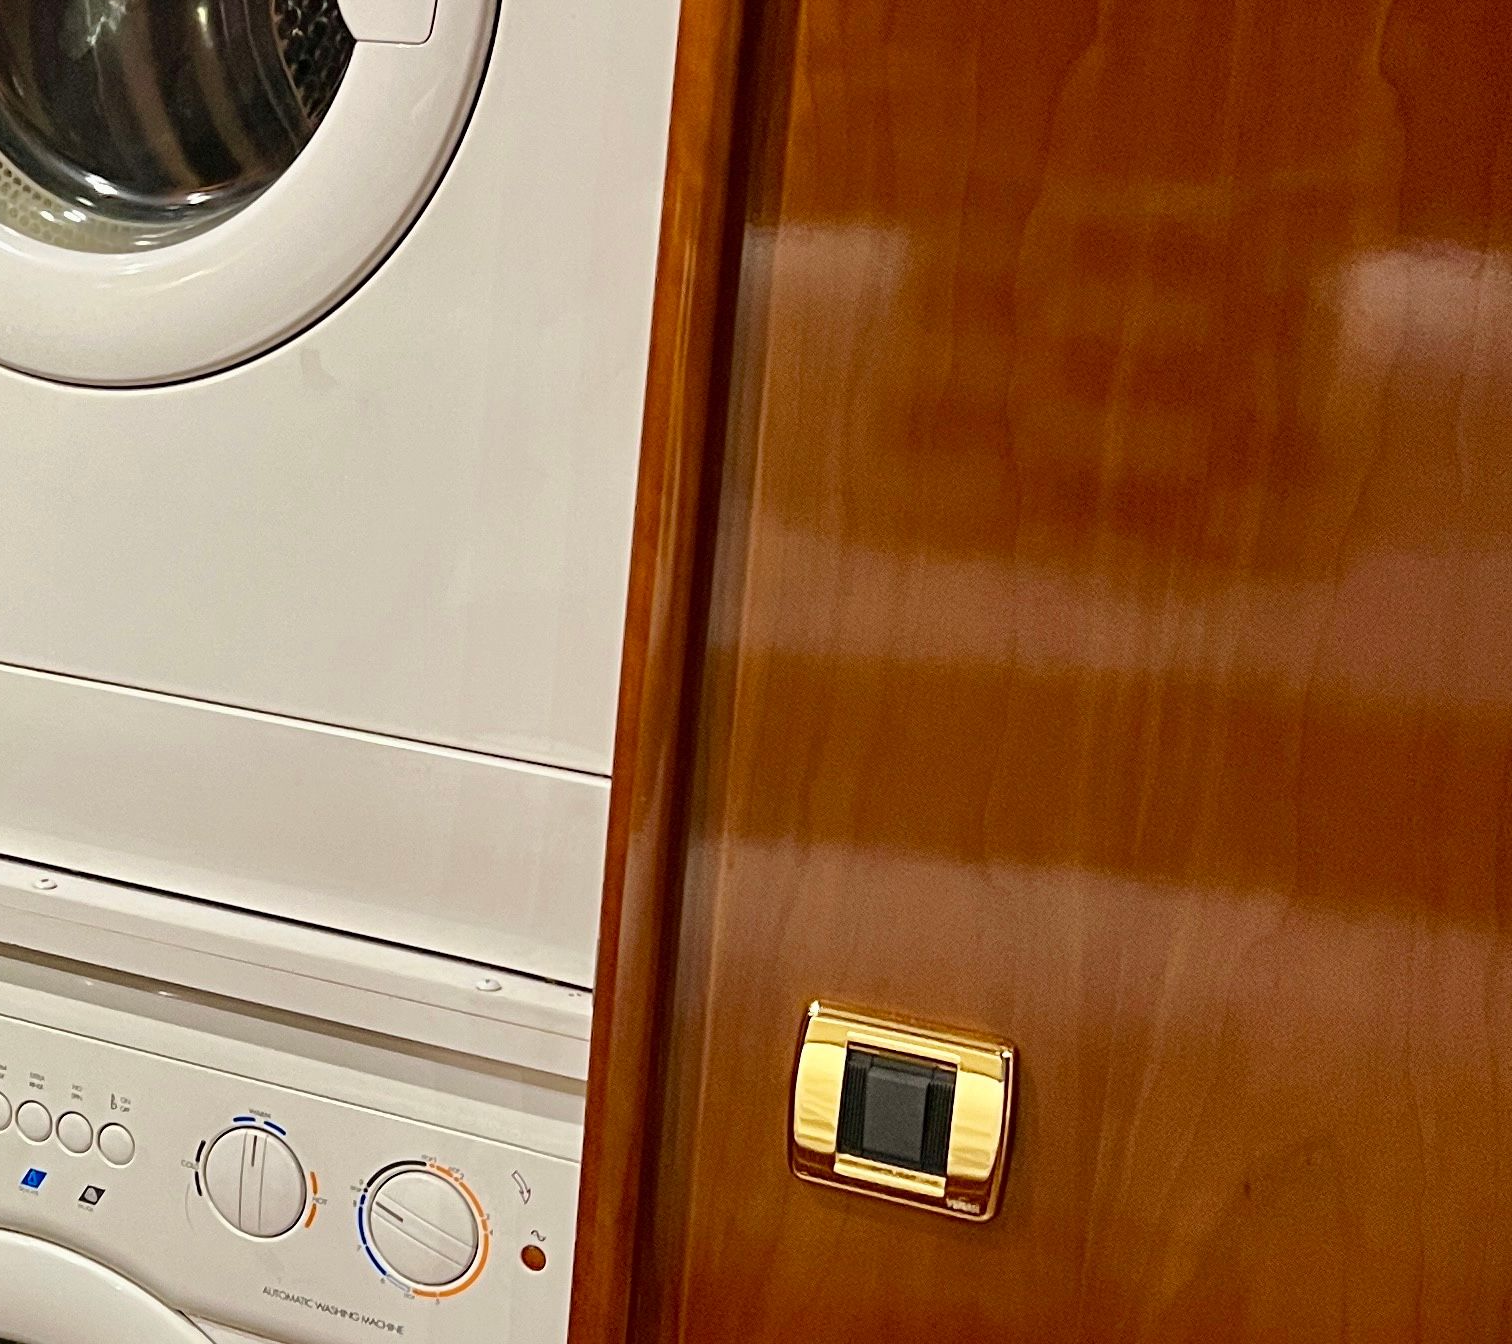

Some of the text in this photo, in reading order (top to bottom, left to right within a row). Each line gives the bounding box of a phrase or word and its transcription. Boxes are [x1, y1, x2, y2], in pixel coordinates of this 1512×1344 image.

[263, 1286, 405, 1335] AUTOMATIC WASHING MACHINE
